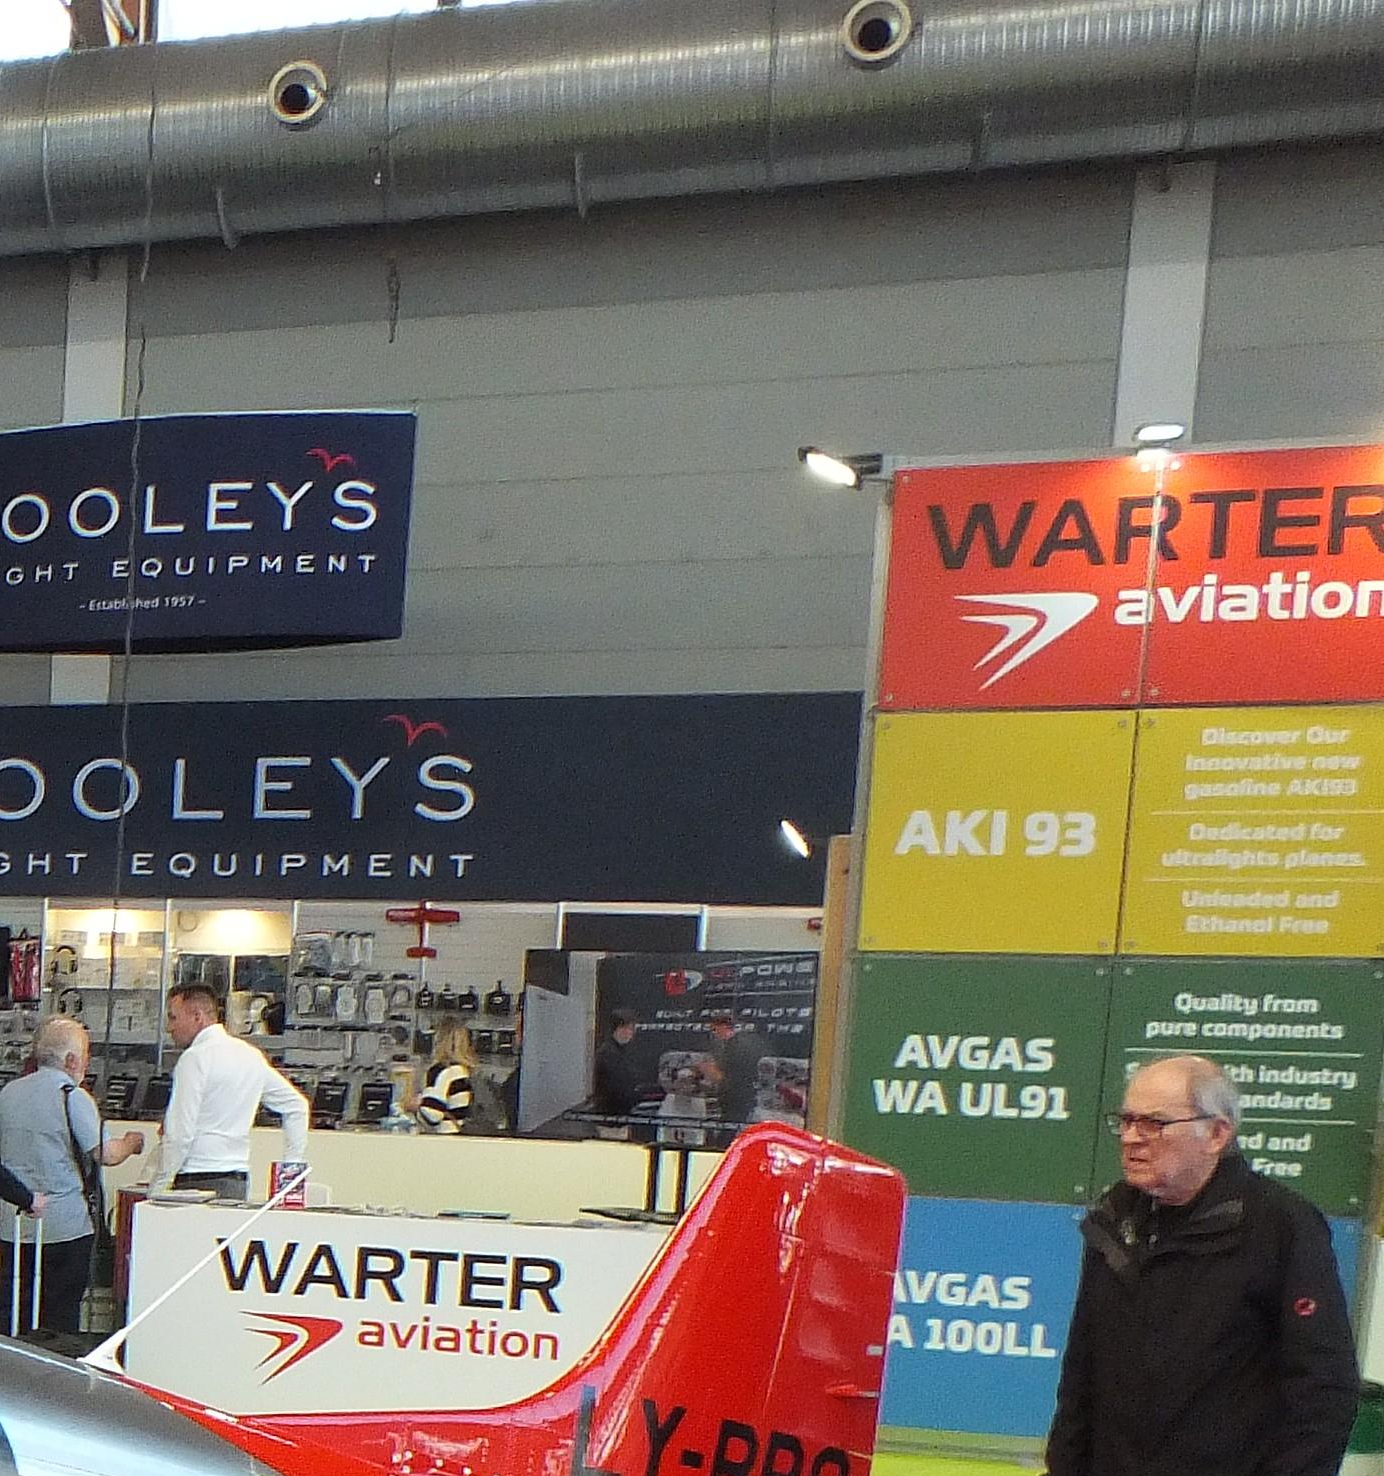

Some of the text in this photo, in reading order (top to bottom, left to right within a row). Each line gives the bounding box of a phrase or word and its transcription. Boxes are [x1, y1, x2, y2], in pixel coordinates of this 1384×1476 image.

[928, 485, 1384, 570] WARTER
[111, 553, 379, 580] EQUIPMENT
[1114, 571, 1384, 625] aviation
[1200, 727, 1301, 746] Discover
[1184, 778, 1282, 800] gasoline
[894, 810, 1097, 858] AKI 93
[1189, 823, 1345, 841] Dedicated for
[131, 852, 476, 880] EQUIPMENT
[1182, 890, 1341, 908] Unleaded and
[1185, 915, 1330, 933] Ethanol Free
[1174, 993, 1321, 1016] Quality from
[1145, 1020, 1345, 1041] pure components
[894, 1034, 1055, 1073] AVGAS
[1259, 1064, 1358, 1089] industry
[872, 1079, 1072, 1121] WA UL91
[1239, 1091, 1333, 1112] andards
[1267, 1133, 1313, 1152] and
[1251, 1157, 1303, 1177] Free
[217, 1236, 563, 1314] WARTER
[358, 1316, 561, 1361] aviation
[923, 1318, 1058, 1359] 100LL
